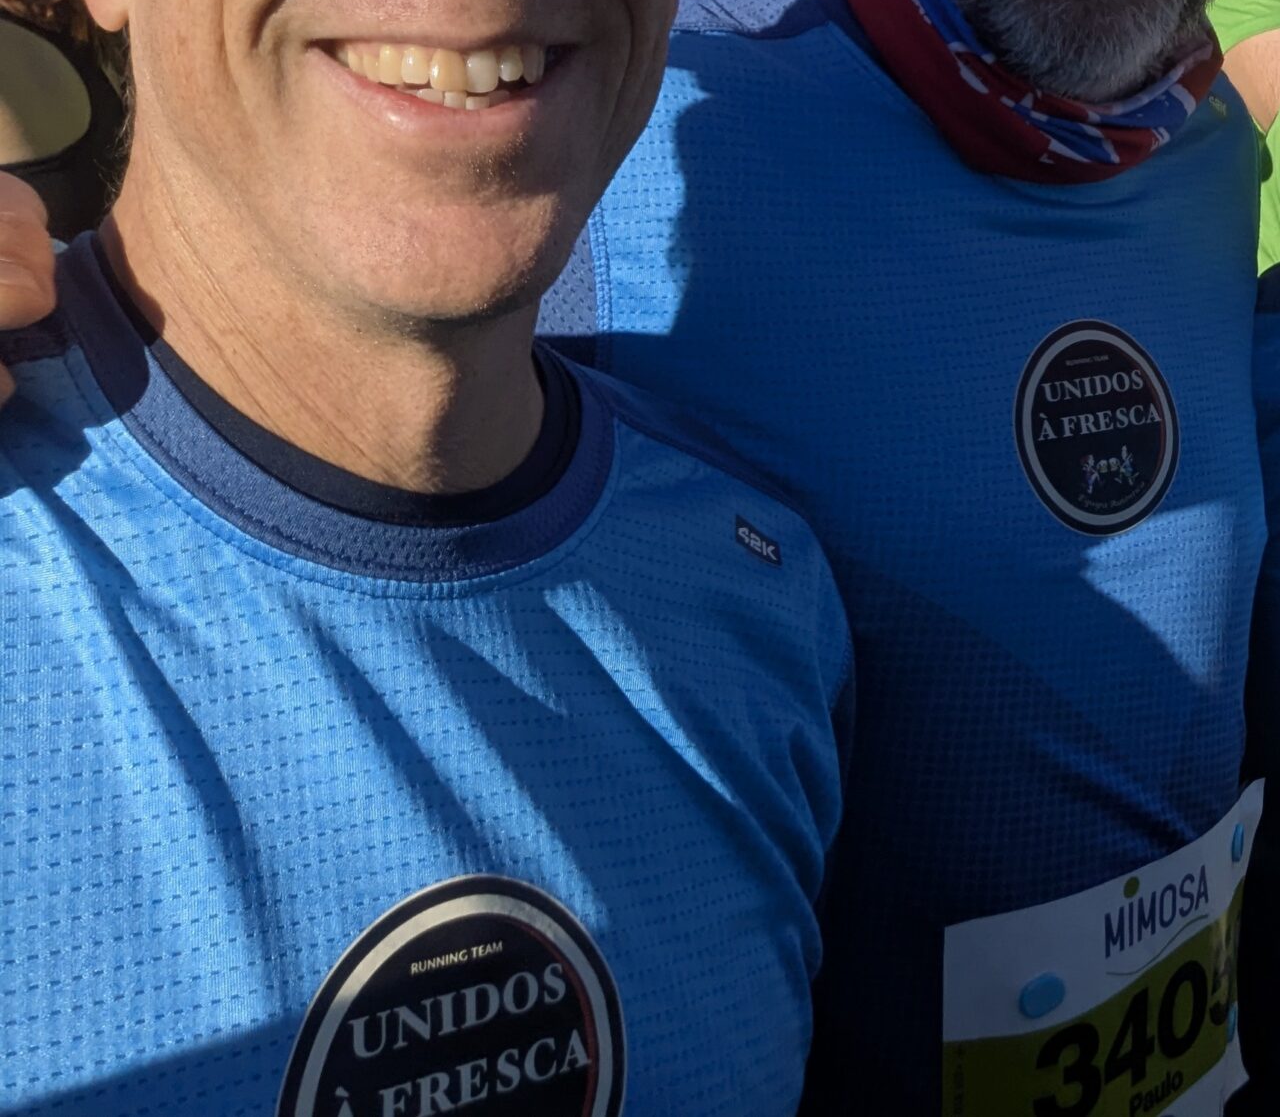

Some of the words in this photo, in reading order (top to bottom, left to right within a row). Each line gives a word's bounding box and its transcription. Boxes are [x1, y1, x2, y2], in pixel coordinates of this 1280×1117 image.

[1042, 369, 1143, 402] UNIDOS
[1038, 413, 1057, 441] À
[1061, 403, 1162, 437] FRESCA
[738, 527, 778, 561] 42K
[1104, 864, 1209, 959] MIMOSA
[410, 949, 468, 975] RUNNING
[471, 940, 503, 960] TEAM
[348, 963, 566, 1059] UNIDOS
[379, 1029, 592, 1117] FRESCA
[1129, 1070, 1184, 1117] Paulo
